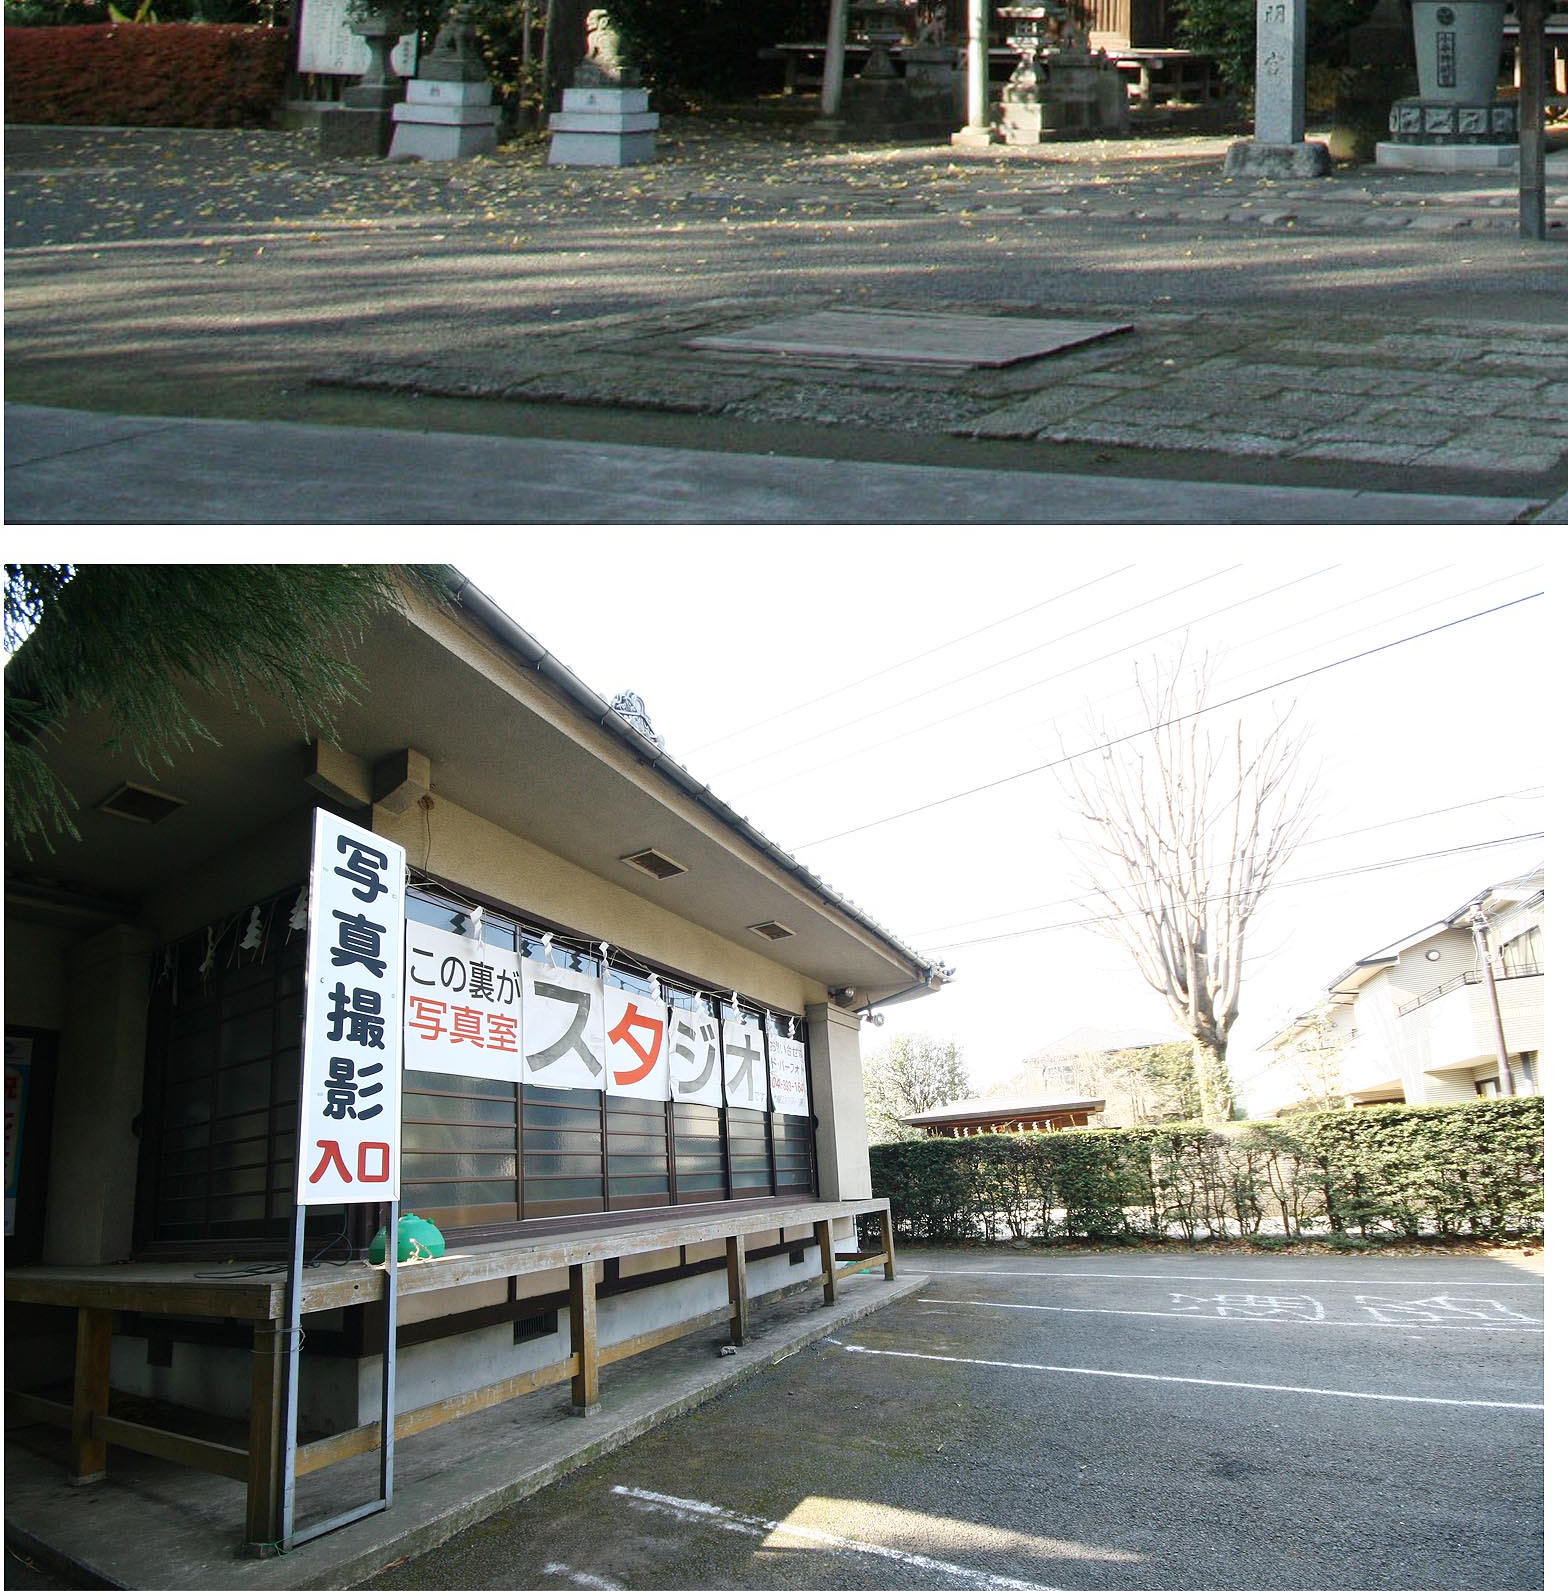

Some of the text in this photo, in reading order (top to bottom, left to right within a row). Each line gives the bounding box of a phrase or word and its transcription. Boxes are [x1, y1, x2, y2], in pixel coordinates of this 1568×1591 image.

[323, 834, 389, 1121] 写真撮影
[410, 946, 521, 1006] この裏が
[409, 995, 519, 1053] 写真室
[526, 980, 761, 1101] スタジオ
[309, 1139, 390, 1183] 入口
